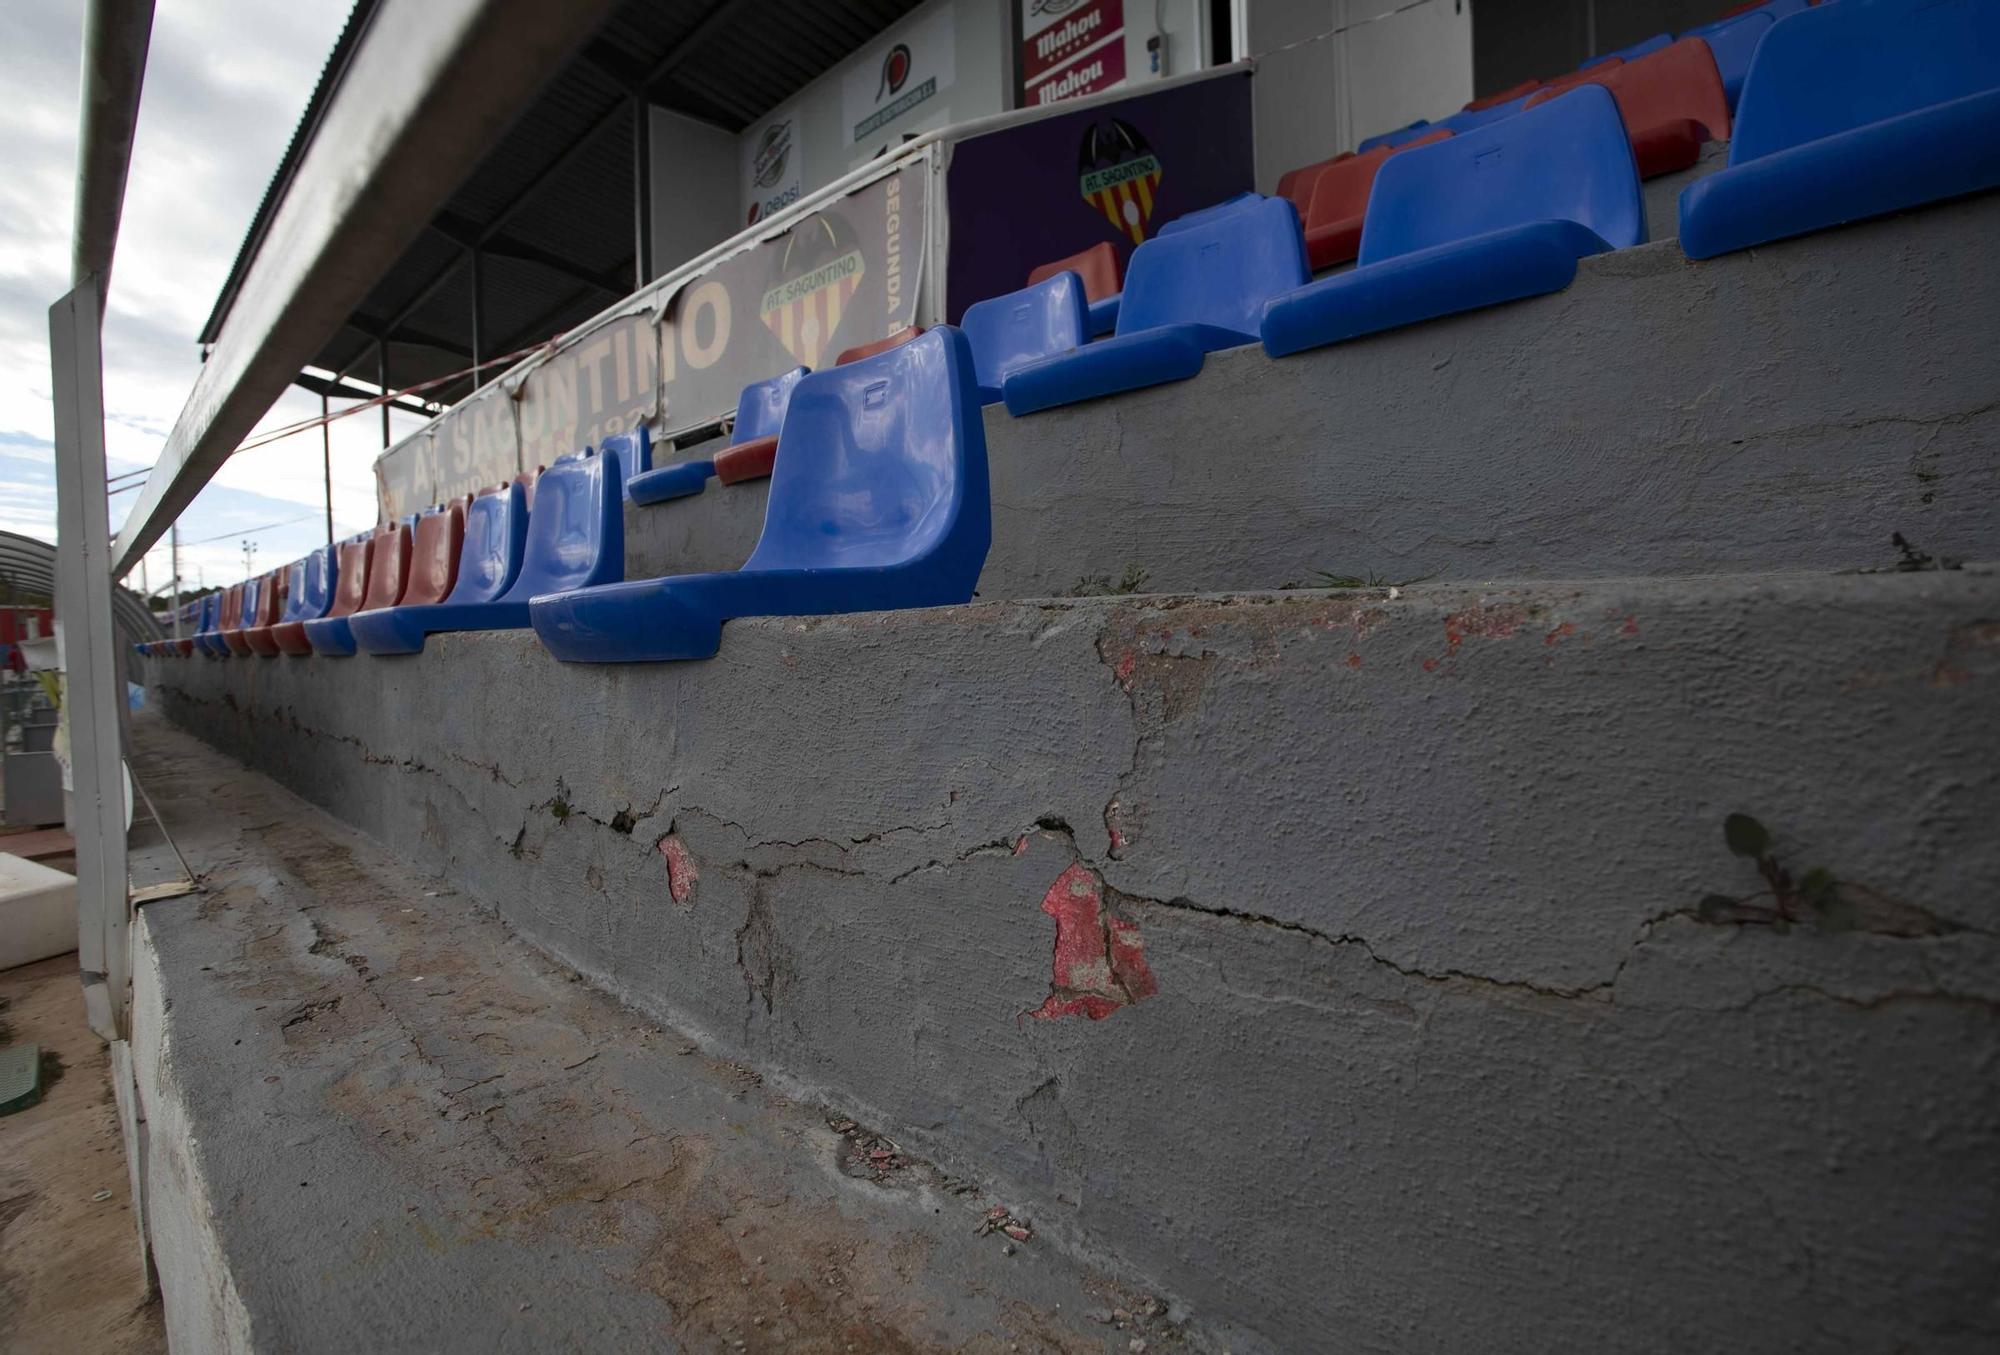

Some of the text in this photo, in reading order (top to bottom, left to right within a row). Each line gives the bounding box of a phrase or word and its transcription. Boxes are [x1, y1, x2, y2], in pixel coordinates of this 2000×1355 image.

[1037, 9, 1101, 59] Mahou
[1039, 59, 1104, 105] Mahou
[765, 180, 800, 217] pepsi
[1086, 157, 1154, 191] AT. SAGUNTINO
[887, 178, 900, 314] SEGUNDA
[767, 255, 855, 309] AT. SAGUNTINO
[412, 282, 733, 494] AT. SAGUNTINO
